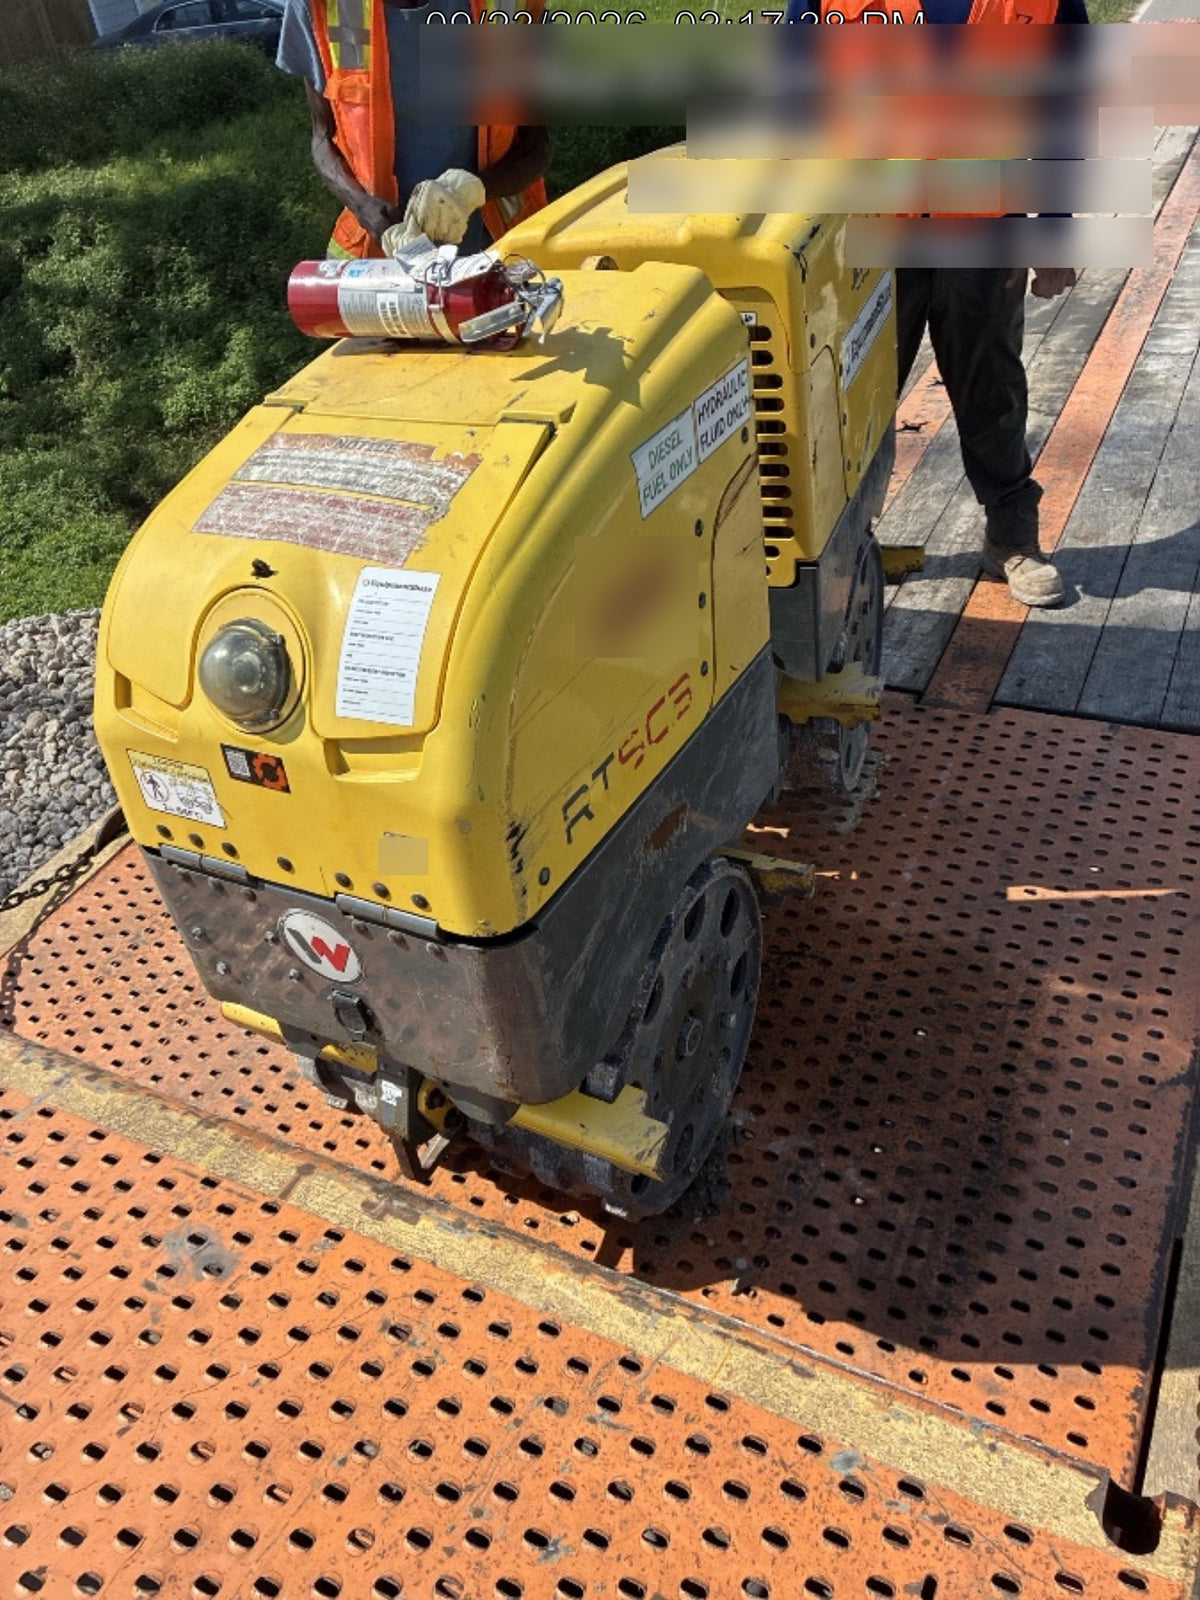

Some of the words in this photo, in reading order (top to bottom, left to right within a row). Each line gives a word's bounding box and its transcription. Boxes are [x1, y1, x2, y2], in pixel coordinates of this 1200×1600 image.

[697, 369, 747, 426] HYDRAULIC
[700, 418, 726, 453] FLUID
[727, 397, 750, 428] ONLY
[334, 437, 401, 453] NOTICE
[648, 428, 684, 470] DIESEL
[642, 472, 669, 507] FUEL
[669, 445, 693, 481] ONLY
